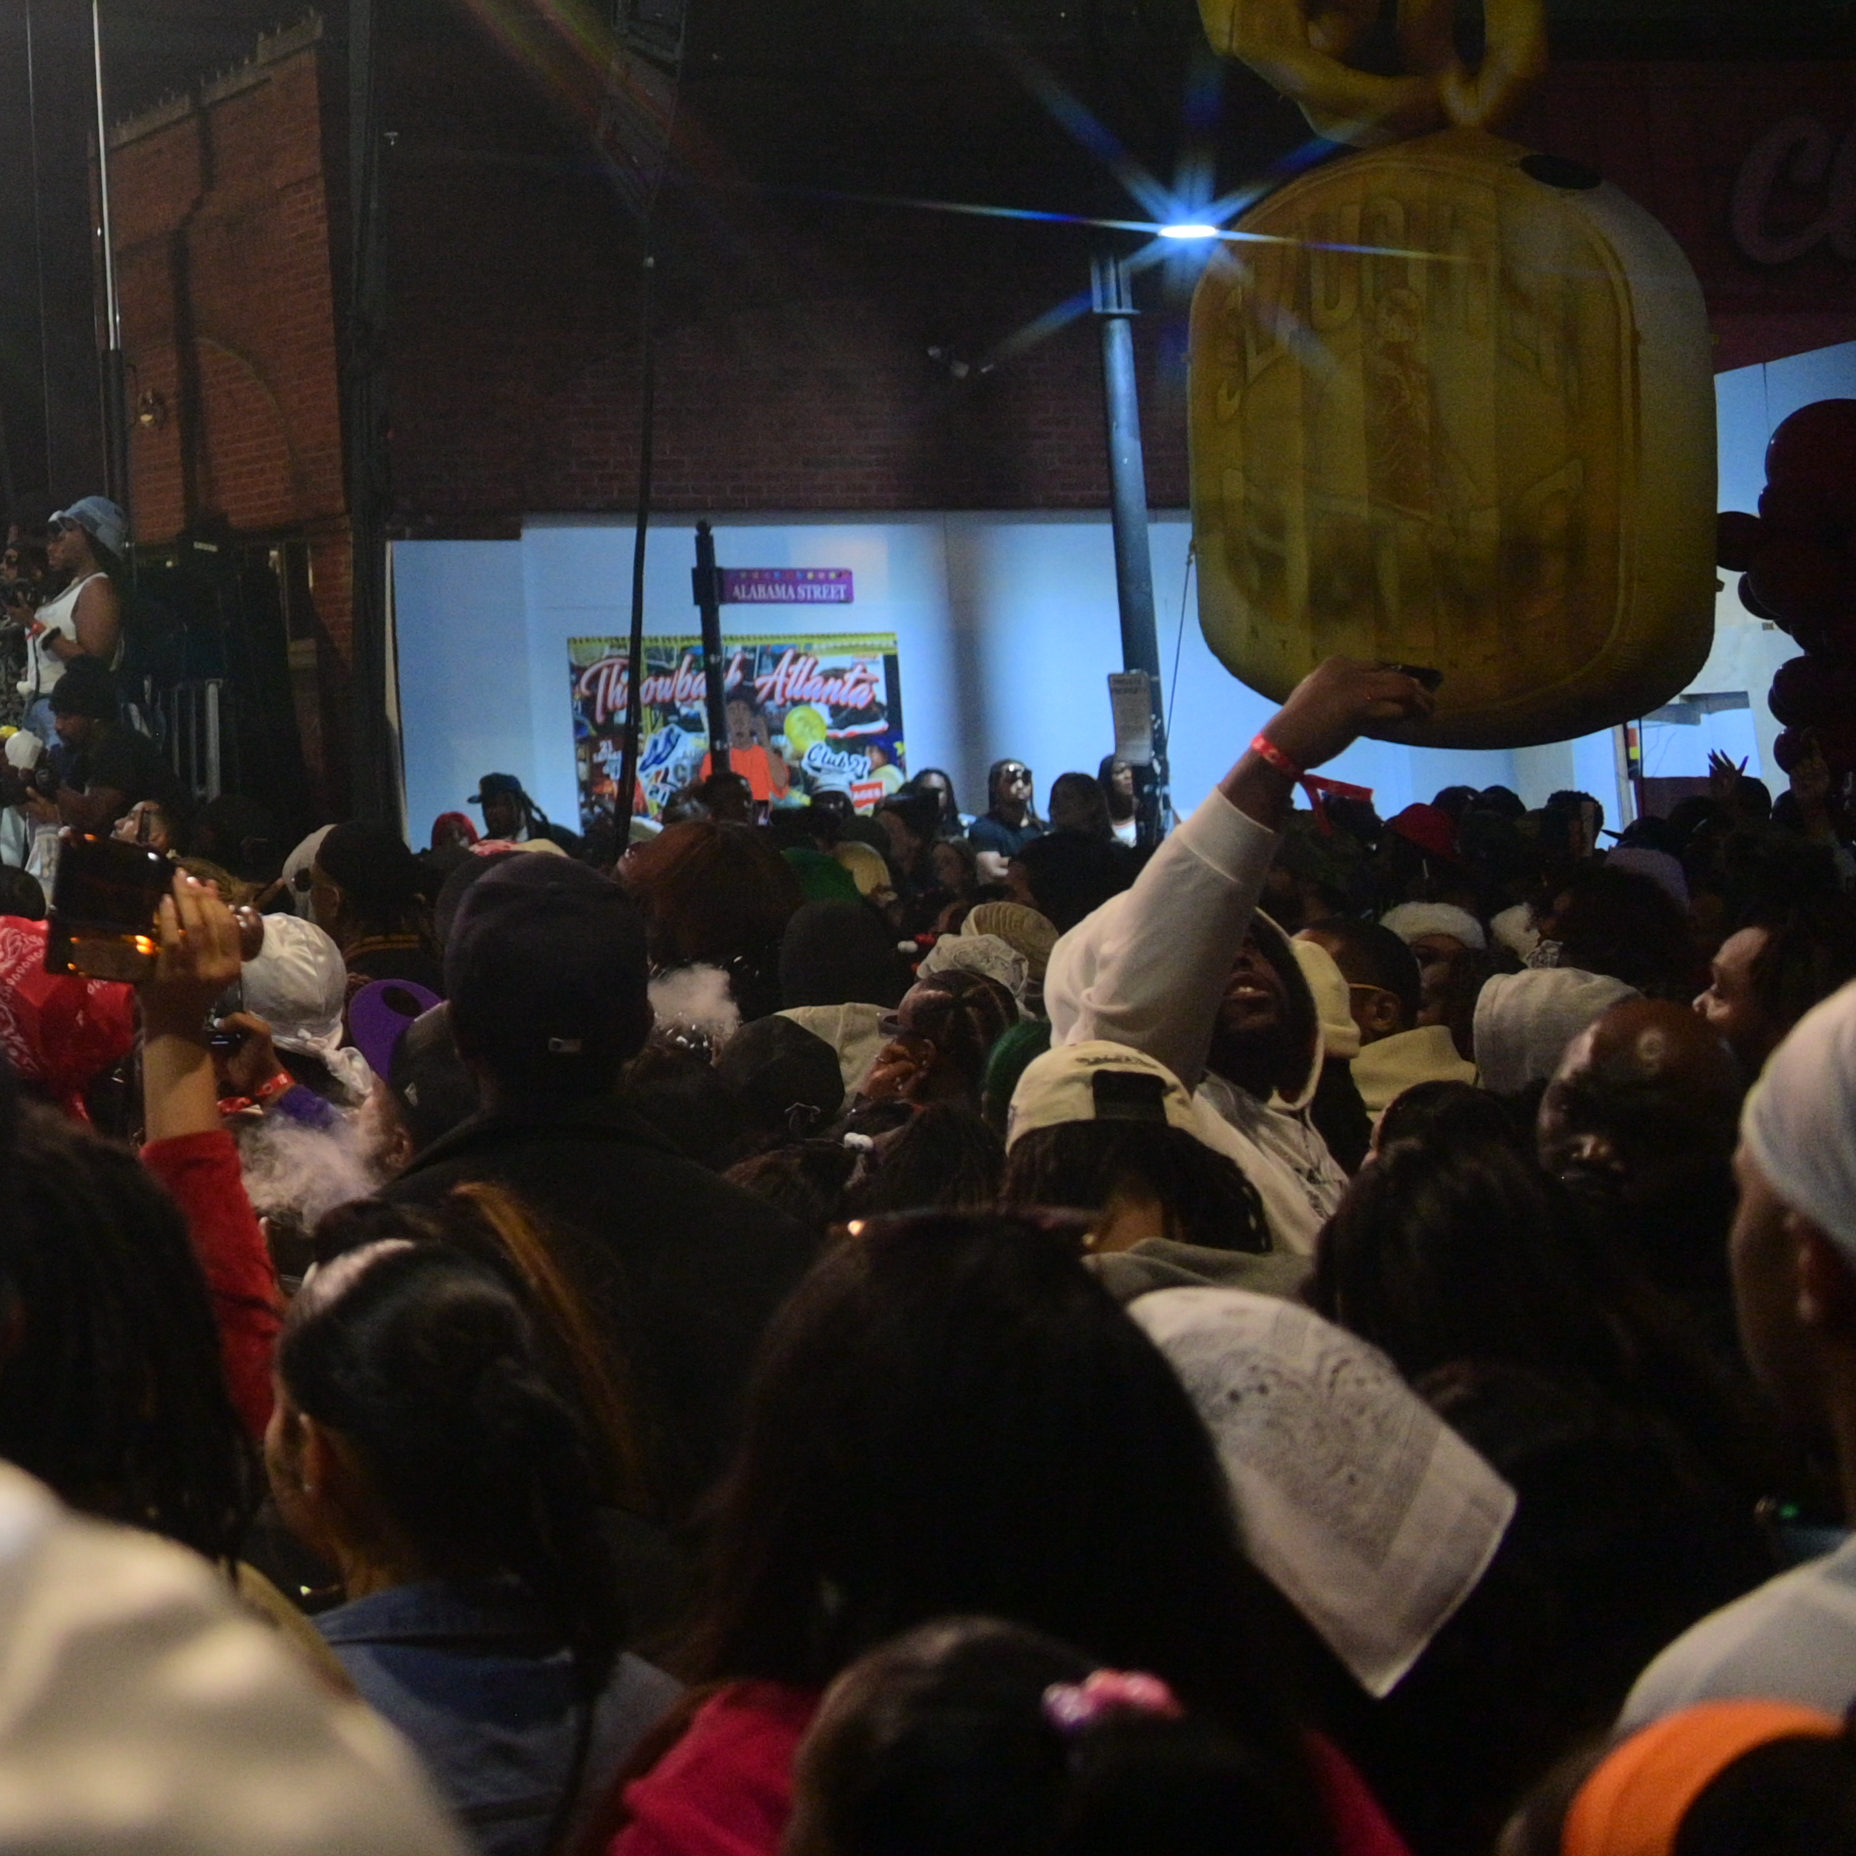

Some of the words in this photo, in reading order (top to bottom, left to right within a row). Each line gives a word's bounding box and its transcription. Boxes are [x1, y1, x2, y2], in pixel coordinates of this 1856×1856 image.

[733, 584, 796, 600] ALABAMA
[796, 584, 847, 600] STREET
[580, 650, 746, 724] Thowbak
[754, 648, 880, 709] Atlanta
[807, 743, 847, 769] Club
